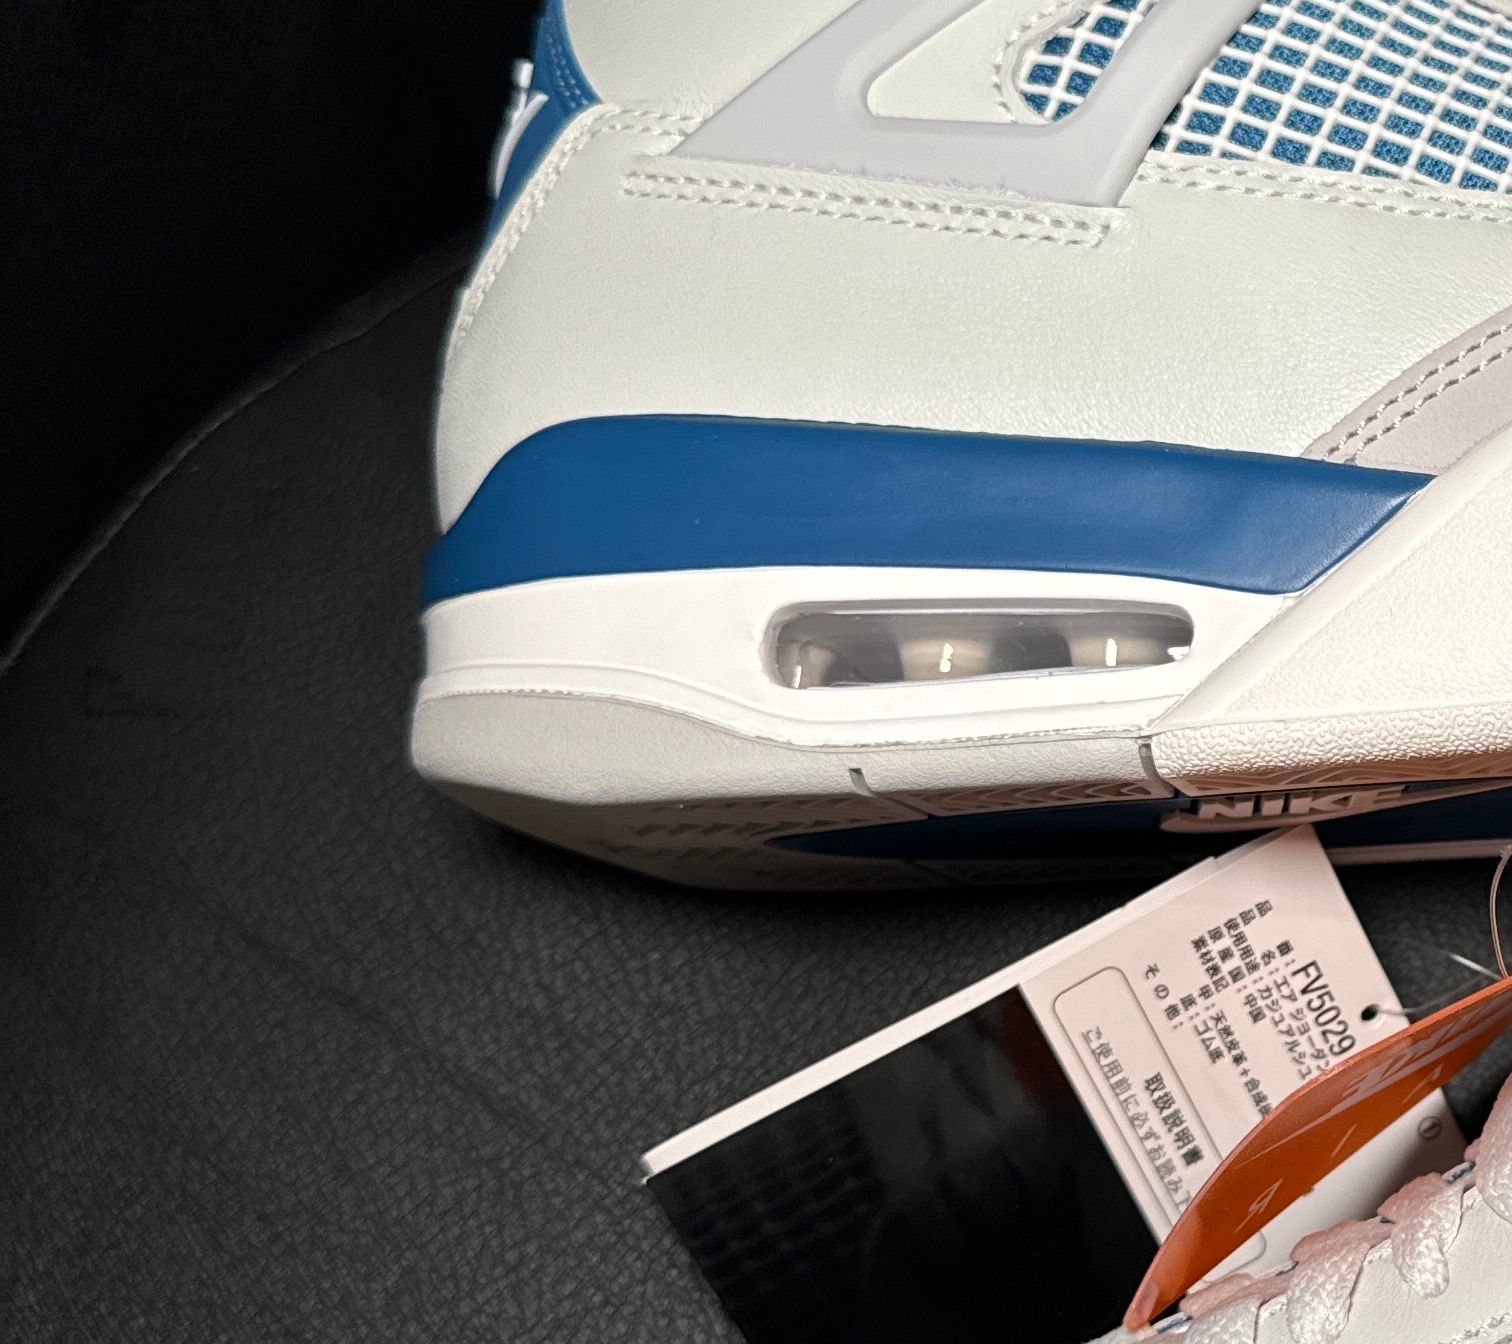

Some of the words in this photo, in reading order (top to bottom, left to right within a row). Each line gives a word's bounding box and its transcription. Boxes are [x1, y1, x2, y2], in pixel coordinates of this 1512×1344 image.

[1195, 785, 1408, 821] NIKE
[1243, 993, 1266, 1024] 中国
[1290, 959, 1355, 1056] FV5029
[1193, 1019, 1224, 1064] ゴム底
[1144, 1071, 1203, 1166] 取扱説明書
